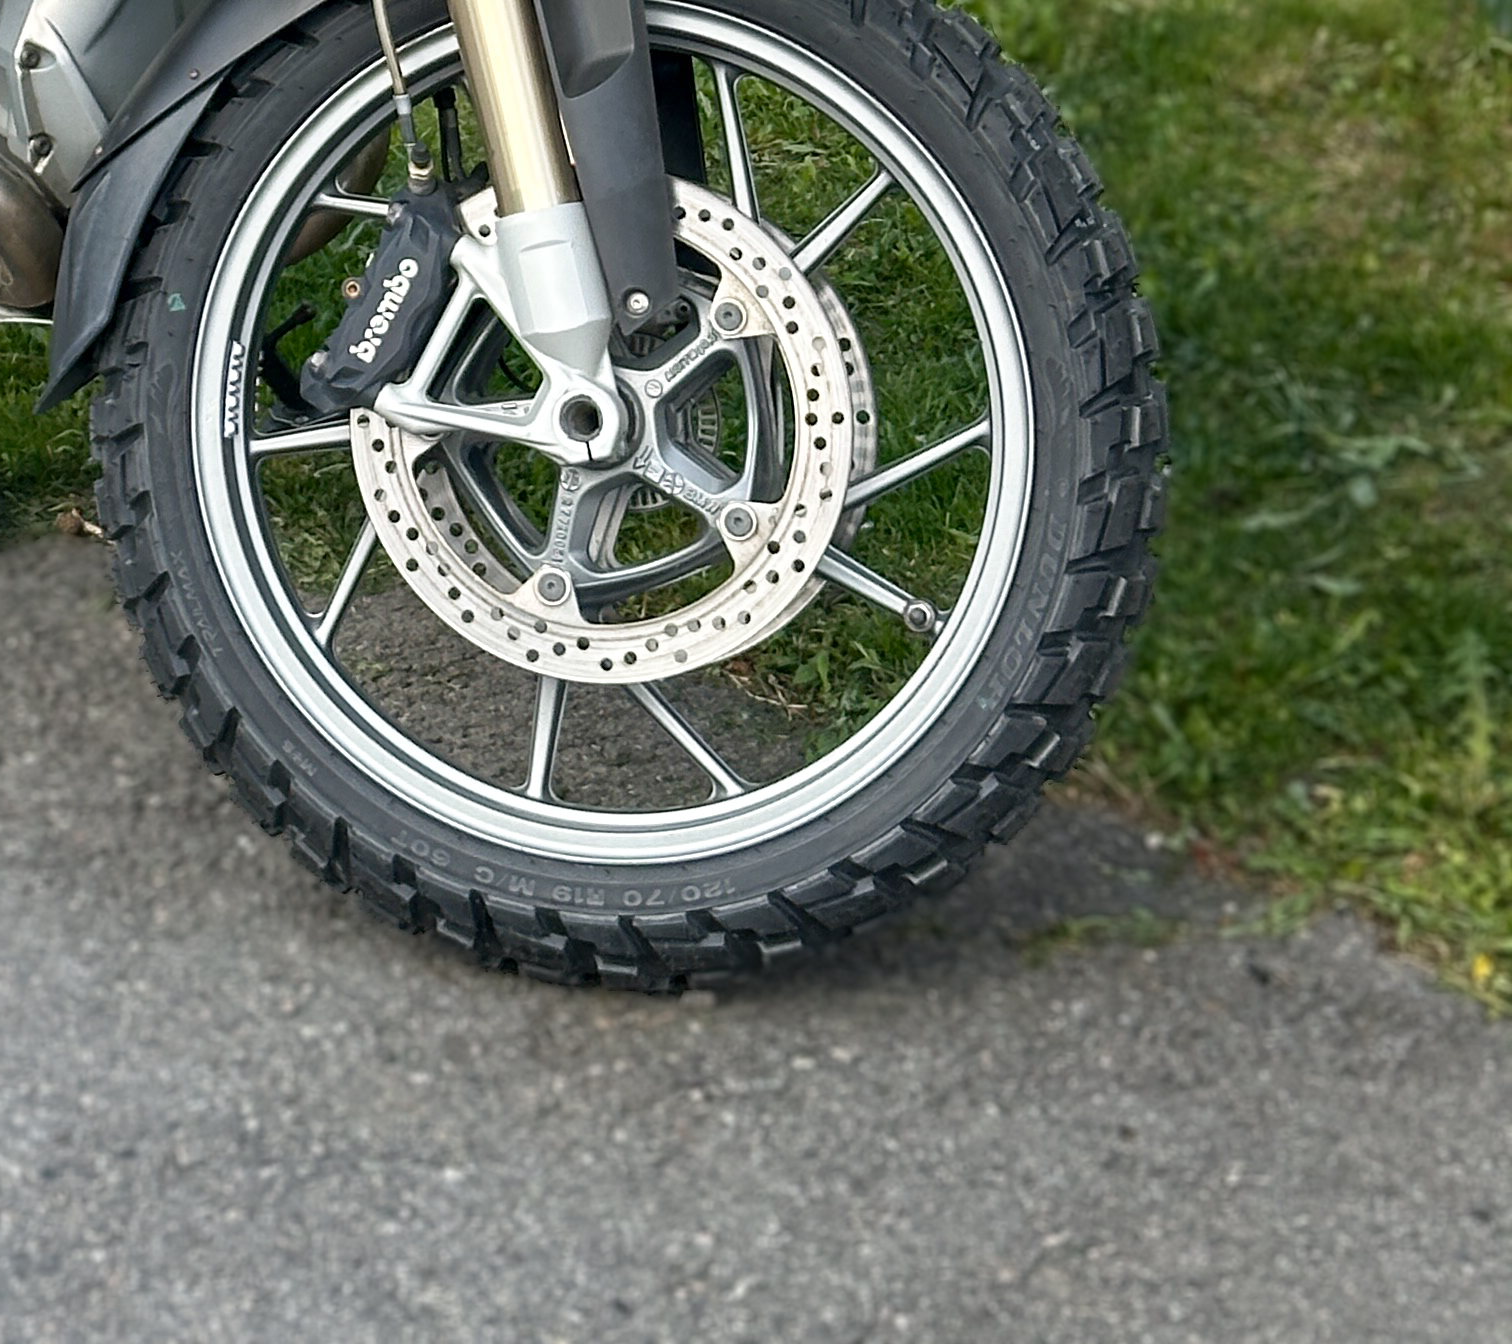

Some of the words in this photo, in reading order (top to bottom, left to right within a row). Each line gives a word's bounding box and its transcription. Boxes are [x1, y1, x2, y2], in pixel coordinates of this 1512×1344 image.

[349, 258, 419, 364] brembo
[169, 550, 224, 658] TRAILMAX
[390, 829, 451, 867] 60T
[473, 865, 537, 897] M/C
[551, 884, 605, 907] R19
[622, 877, 736, 907] 120/70
